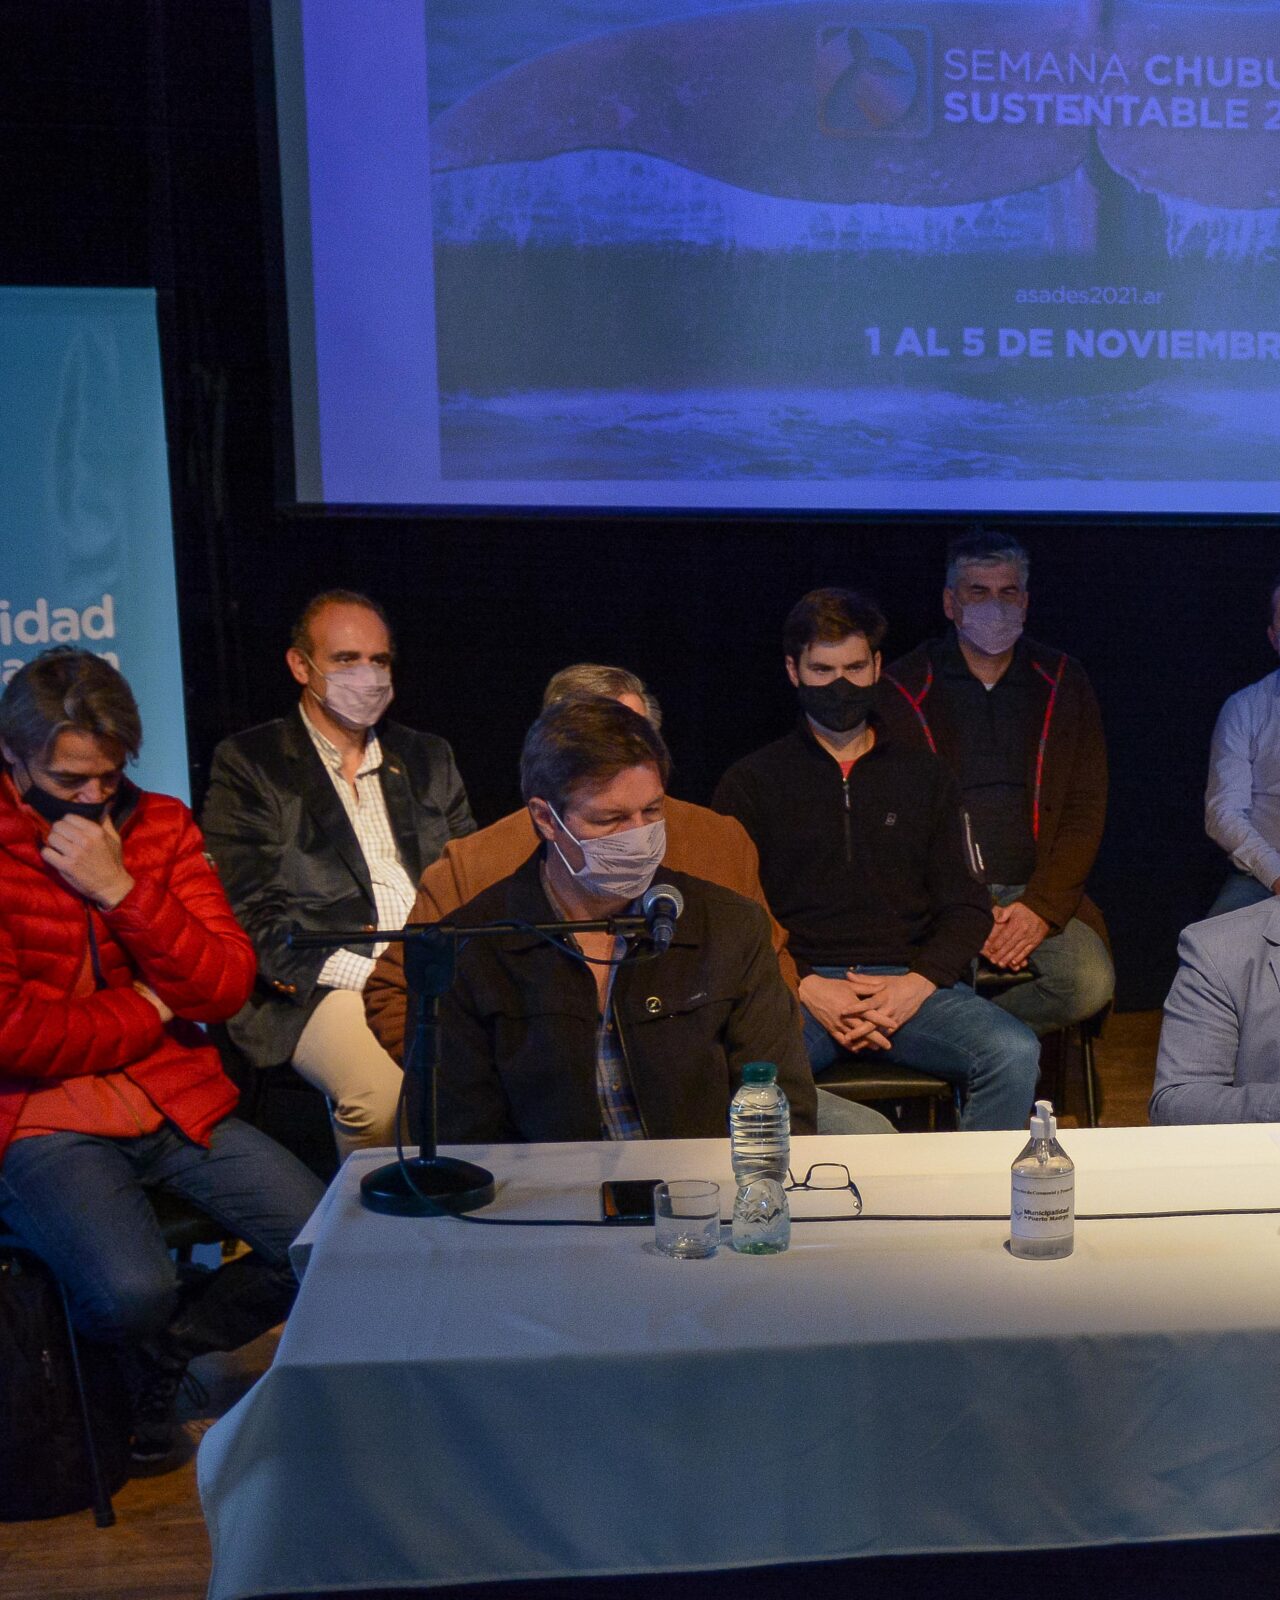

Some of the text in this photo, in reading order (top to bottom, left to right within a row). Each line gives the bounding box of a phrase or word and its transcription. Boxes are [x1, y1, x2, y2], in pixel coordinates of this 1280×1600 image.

[944, 48, 1130, 84] SEMANA
[944, 91, 1249, 128] SUSTENTABLE
[1015, 285, 1164, 305] asades2021.ar
[864, 327, 881, 357] 1
[895, 327, 950, 357] AL
[963, 327, 985, 357] 5
[998, 328, 1053, 358] DE
